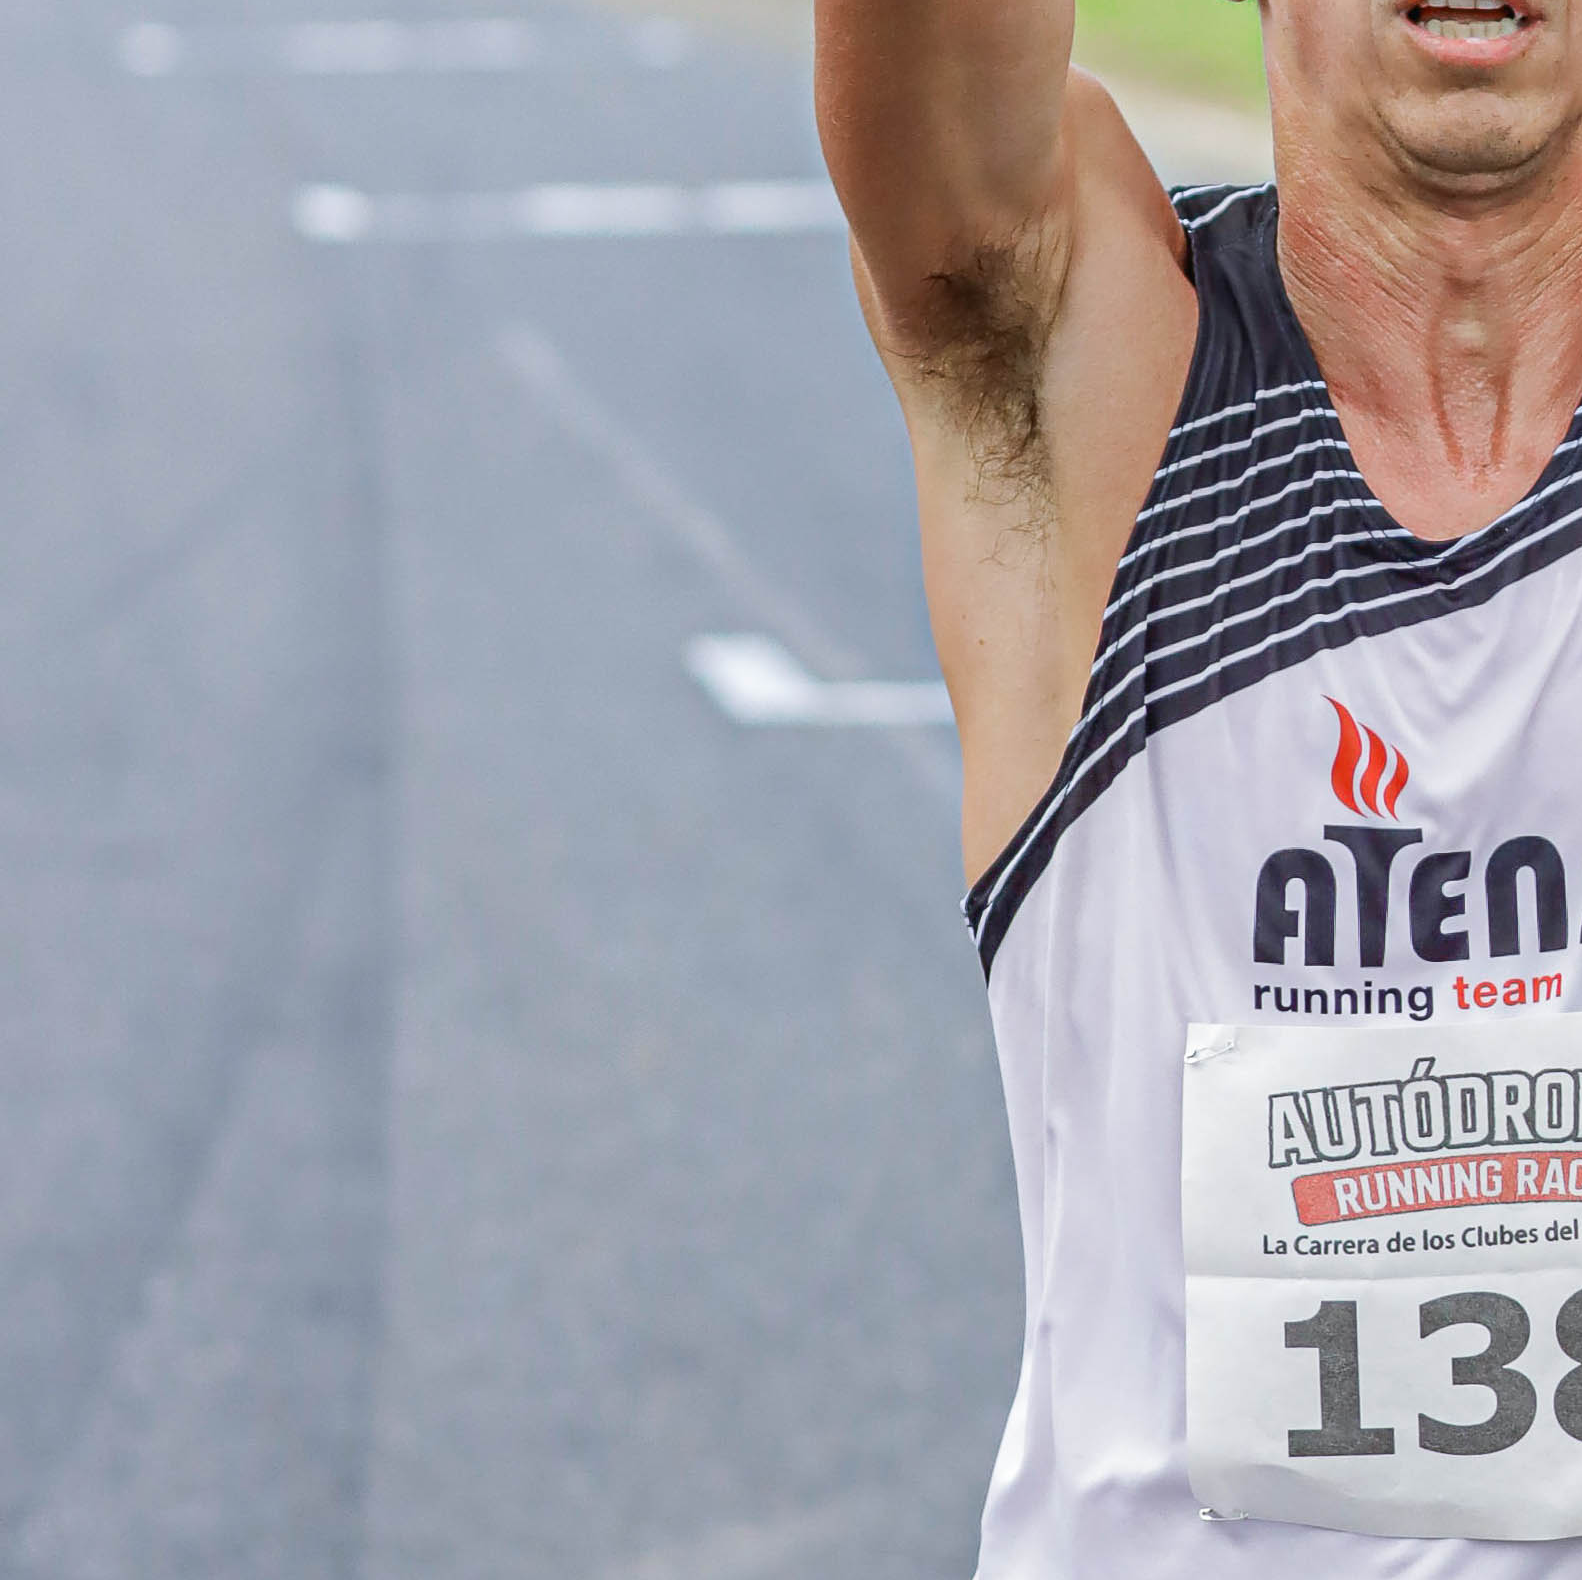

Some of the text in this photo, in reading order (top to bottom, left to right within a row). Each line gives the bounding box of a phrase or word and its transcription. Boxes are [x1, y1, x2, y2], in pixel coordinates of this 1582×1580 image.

[1253, 972, 1563, 1021] running team
[1333, 1161, 1503, 1217] RUNNING
[1262, 1235, 1287, 1256] La
[1293, 1233, 1380, 1257] Carrera
[1386, 1231, 1416, 1253] de
[1422, 1229, 1455, 1251] los
[1461, 1224, 1539, 1249] Clubes
[1545, 1219, 1579, 1242] del
